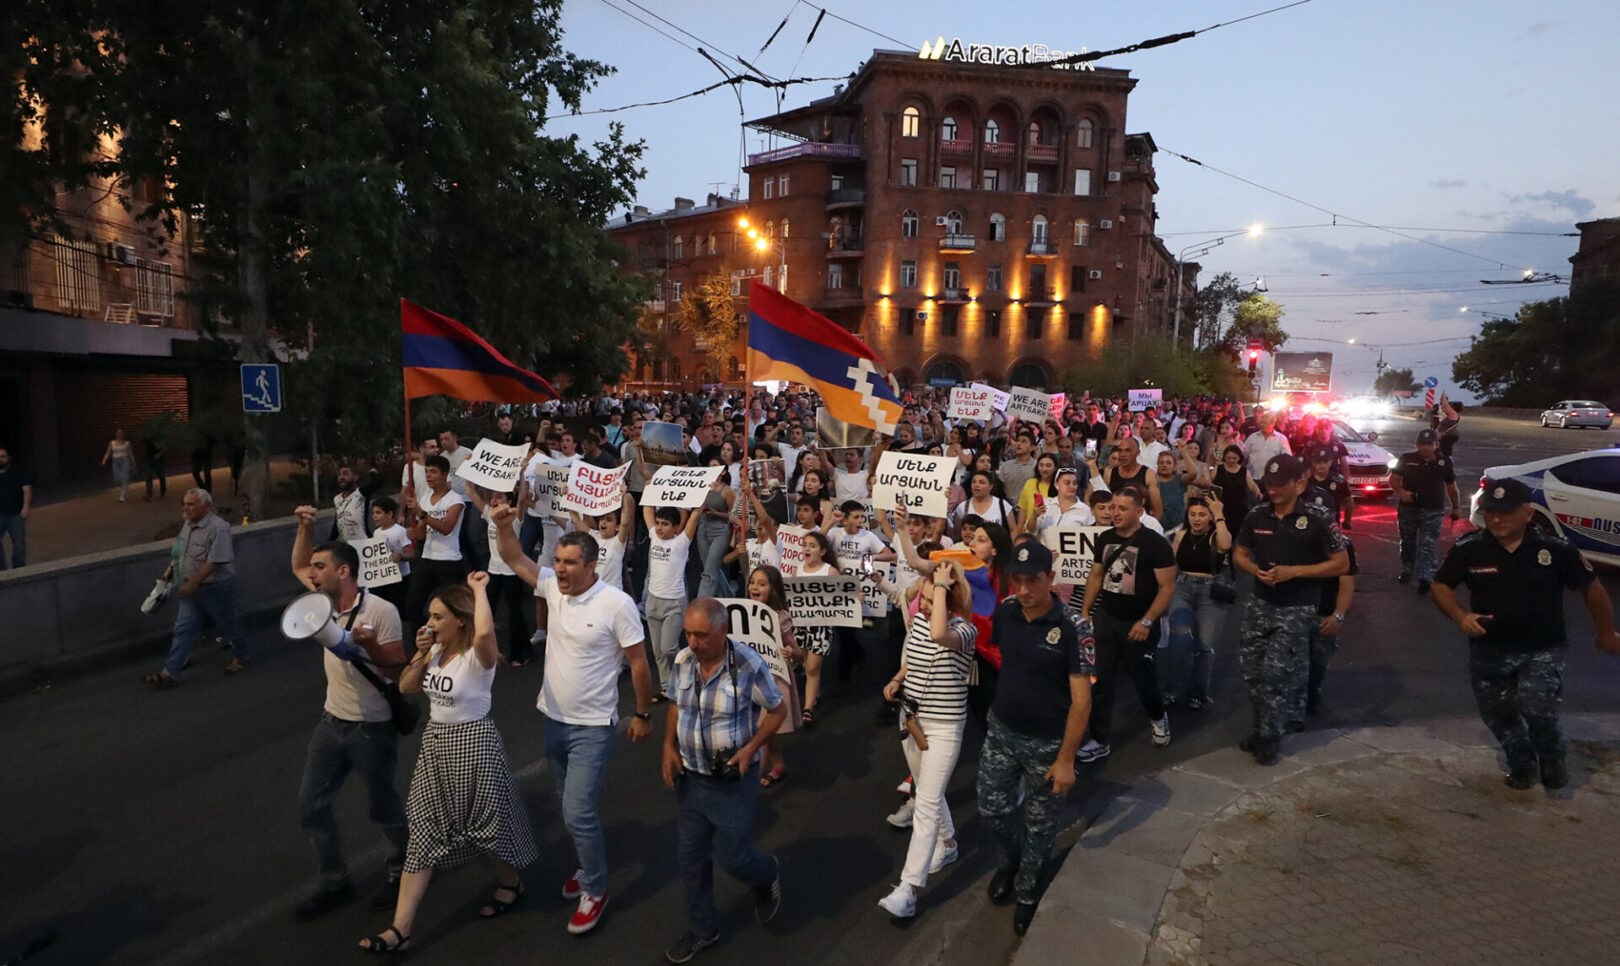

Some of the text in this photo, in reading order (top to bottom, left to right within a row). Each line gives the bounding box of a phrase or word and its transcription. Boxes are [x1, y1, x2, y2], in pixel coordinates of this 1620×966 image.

[956, 391, 988, 400] ՄԵՆՔ
[1013, 394, 1029, 404] WE
[1031, 398, 1048, 410] ARE
[957, 408, 980, 416] ԵՆՔ
[1010, 402, 1046, 417] ARTSAKH
[480, 449, 522, 468] WE ARE
[896, 459, 937, 473] ՄԵՆՔ
[653, 477, 707, 489] ԱՐՑԱԽՆ
[880, 474, 943, 491] ԱՐՑԱԽՆ
[661, 490, 687, 501] ԵՆՔ
[1566, 516, 1583, 526] 1-02
[778, 531, 807, 547] ОТКРО
[1059, 532, 1099, 555] EN
[781, 548, 805, 562] ДОРО
[362, 559, 379, 569] THE
[1061, 558, 1093, 569] ARTS
[364, 565, 398, 581] OF LIFE
[1061, 569, 1090, 579] BLOC
[790, 609, 855, 619] ԱՆԱՊԱՐՀԸ
[422, 672, 454, 693] END
